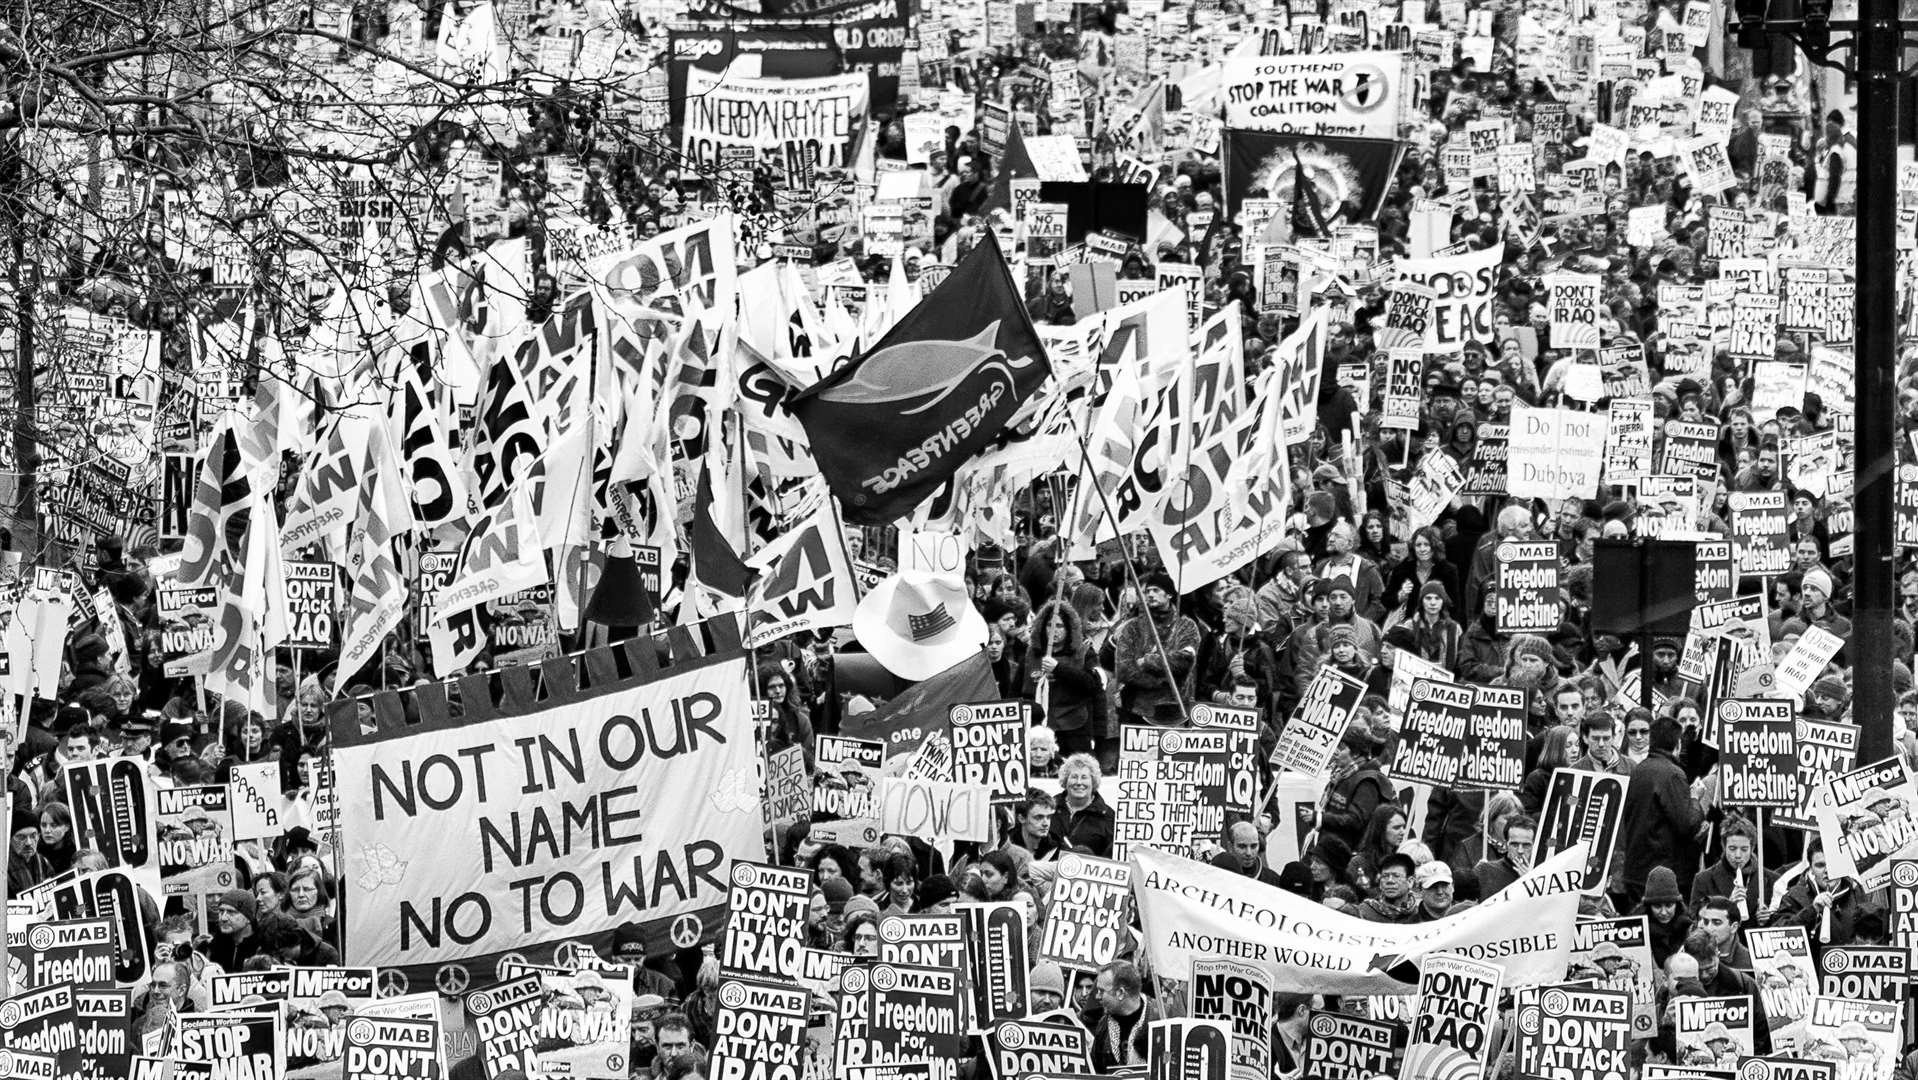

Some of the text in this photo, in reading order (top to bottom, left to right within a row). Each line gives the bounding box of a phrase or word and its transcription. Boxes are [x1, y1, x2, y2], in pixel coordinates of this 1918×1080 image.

[1255, 63, 1344, 75] SOUTHEND
[1229, 78, 1345, 103] STOP THE WAR
[1250, 102, 1336, 116] COALITION
[1281, 123, 1308, 134] Our
[340, 201, 393, 217] BUSH
[1035, 215, 1053, 224] NO
[1029, 224, 1063, 235] WAR
[1394, 291, 1432, 309] DON'T
[1555, 285, 1594, 297] DON'T
[1555, 298, 1595, 307] ATTACK
[1387, 314, 1426, 336] IRAQ
[1554, 308, 1595, 325] IRAQ
[1786, 306, 1826, 328] IRAQ
[1730, 331, 1776, 358] IRAQ
[1528, 416, 1589, 437] Do not
[1683, 425, 1715, 437] MAB
[1524, 463, 1585, 490] Dubbya
[1749, 496, 1782, 506] MAB
[1733, 511, 1786, 536] Freedom
[912, 535, 960, 572] NO
[1519, 546, 1554, 557] MAB
[1733, 544, 1790, 572] Palestine
[295, 566, 330, 578] MAB
[1500, 563, 1557, 588] Freedom
[1519, 590, 1538, 601] For
[1498, 599, 1558, 627] Palestine
[1681, 660, 1703, 676] FOR OIL
[1431, 687, 1471, 705] MAB
[1483, 692, 1522, 705] MAB
[976, 706, 1018, 720] MAB
[1215, 711, 1255, 727] MAB
[1302, 698, 1346, 733] WAR
[1405, 702, 1466, 740] Freedom
[1745, 706, 1789, 718] MAB
[891, 727, 921, 743] one
[952, 722, 1023, 748] DON'T
[1185, 735, 1225, 749] MAB
[1419, 733, 1440, 749] For
[1481, 738, 1500, 751] For
[1724, 724, 1793, 755] Freedom
[1811, 728, 1853, 745] MAB
[370, 691, 727, 821] NOT IN OUR
[822, 739, 882, 762] Mirror
[954, 742, 1024, 766] ATTACK
[1392, 739, 1459, 782] Palestine
[1748, 755, 1769, 769] For
[1120, 760, 1195, 781] HAS BUSH
[1459, 746, 1523, 784] Palestine
[1118, 781, 1195, 802] SEEN THE
[1723, 764, 1797, 801] Palestine
[1832, 763, 1902, 805] Mirror
[160, 789, 224, 815] Mirror
[814, 788, 840, 813] NO
[67, 760, 149, 870] NO
[1117, 802, 1193, 823] FLIES THAT
[479, 785, 643, 873] NAME
[1115, 823, 1192, 843] FEED OFF
[159, 842, 186, 866] NO
[760, 873, 806, 890] MAB
[1083, 863, 1127, 882] MAB
[400, 839, 729, 951] NO TO WAR
[730, 887, 810, 920] DON'T
[1053, 878, 1129, 910] DON'T
[1049, 901, 1122, 930] ATTACK
[1144, 868, 1583, 949] ARCHAEOLOGISTS WAR
[59, 927, 108, 943] MAB
[728, 914, 804, 939] ATTACK
[910, 923, 958, 937] MAB
[1042, 918, 1117, 965] IRAQ
[1168, 930, 1268, 962] ANOTHER
[1273, 946, 1352, 973] WORLD
[1455, 933, 1558, 961] POSSIBLE
[1753, 931, 1805, 958] Mirror
[723, 930, 802, 980] IRAQ
[882, 943, 964, 968] DON'T
[1853, 954, 1903, 970] MAB
[34, 949, 111, 986] Freedom
[1196, 964, 1214, 972] Stop
[1229, 965, 1244, 973] War
[1464, 964, 1495, 978] Coalition
[216, 977, 289, 1003] Mirror
[298, 970, 371, 998] Mirror
[493, 980, 540, 1003] MAB
[901, 973, 951, 990] MAB
[1196, 974, 1269, 1009] NOT
[1422, 972, 1493, 1006] DON'T
[1823, 976, 1907, 1000] DON'T
[24, 991, 70, 1012] MAB
[77, 998, 123, 1013] MAB
[399, 1003, 431, 1012] Coalition
[750, 992, 803, 1010] MAB
[1195, 998, 1223, 1015] IN
[1369, 995, 1400, 1021] NO
[1419, 995, 1488, 1025] ATTACK
[1573, 996, 1624, 1015] MAB
[183, 1017, 242, 1029] Socialist Worker
[875, 992, 954, 1035] Freedom
[1681, 1002, 1748, 1031] Mirror
[1813, 999, 1895, 1027] Mirror
[4, 1020, 76, 1053] Freedom
[379, 1026, 430, 1043] MAB
[540, 1008, 630, 1044] NO WAR
[716, 1008, 806, 1044] DON'T
[1340, 1023, 1389, 1045] MAB
[1412, 1015, 1484, 1060] IRAQ
[1541, 1018, 1630, 1049] DON'T
[184, 1026, 251, 1060] STOP
[714, 1036, 800, 1066] ATTACK
[901, 1032, 926, 1049] For
[1028, 1031, 1079, 1049] MAB
[211, 1054, 272, 1080] WAR
[348, 1046, 437, 1076] DON'T
[1310, 1039, 1393, 1072] DON'T
[1540, 1049, 1627, 1074] ATTACK
[15, 1059, 52, 1077] MAB
